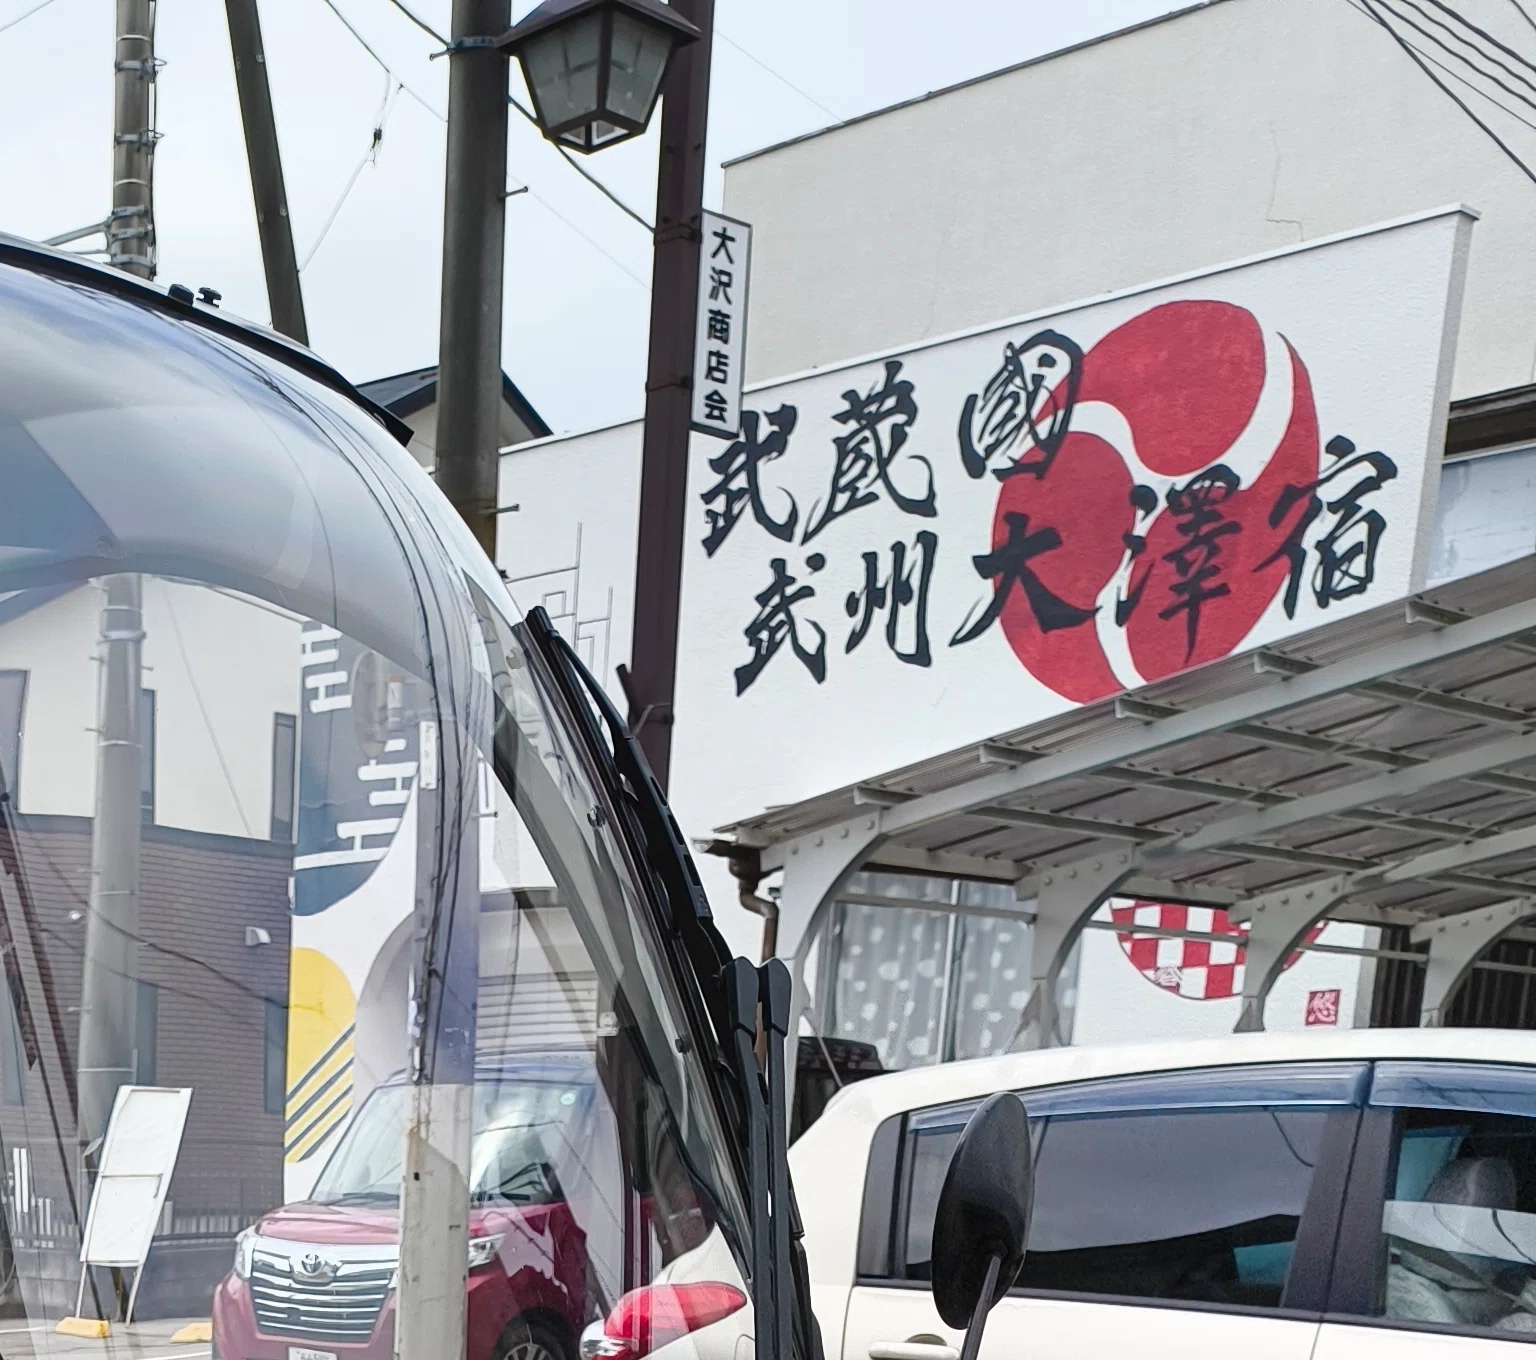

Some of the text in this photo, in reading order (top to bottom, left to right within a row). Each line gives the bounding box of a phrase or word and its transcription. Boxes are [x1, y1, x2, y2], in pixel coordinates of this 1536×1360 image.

[703, 226, 737, 424] 大沢商店会
